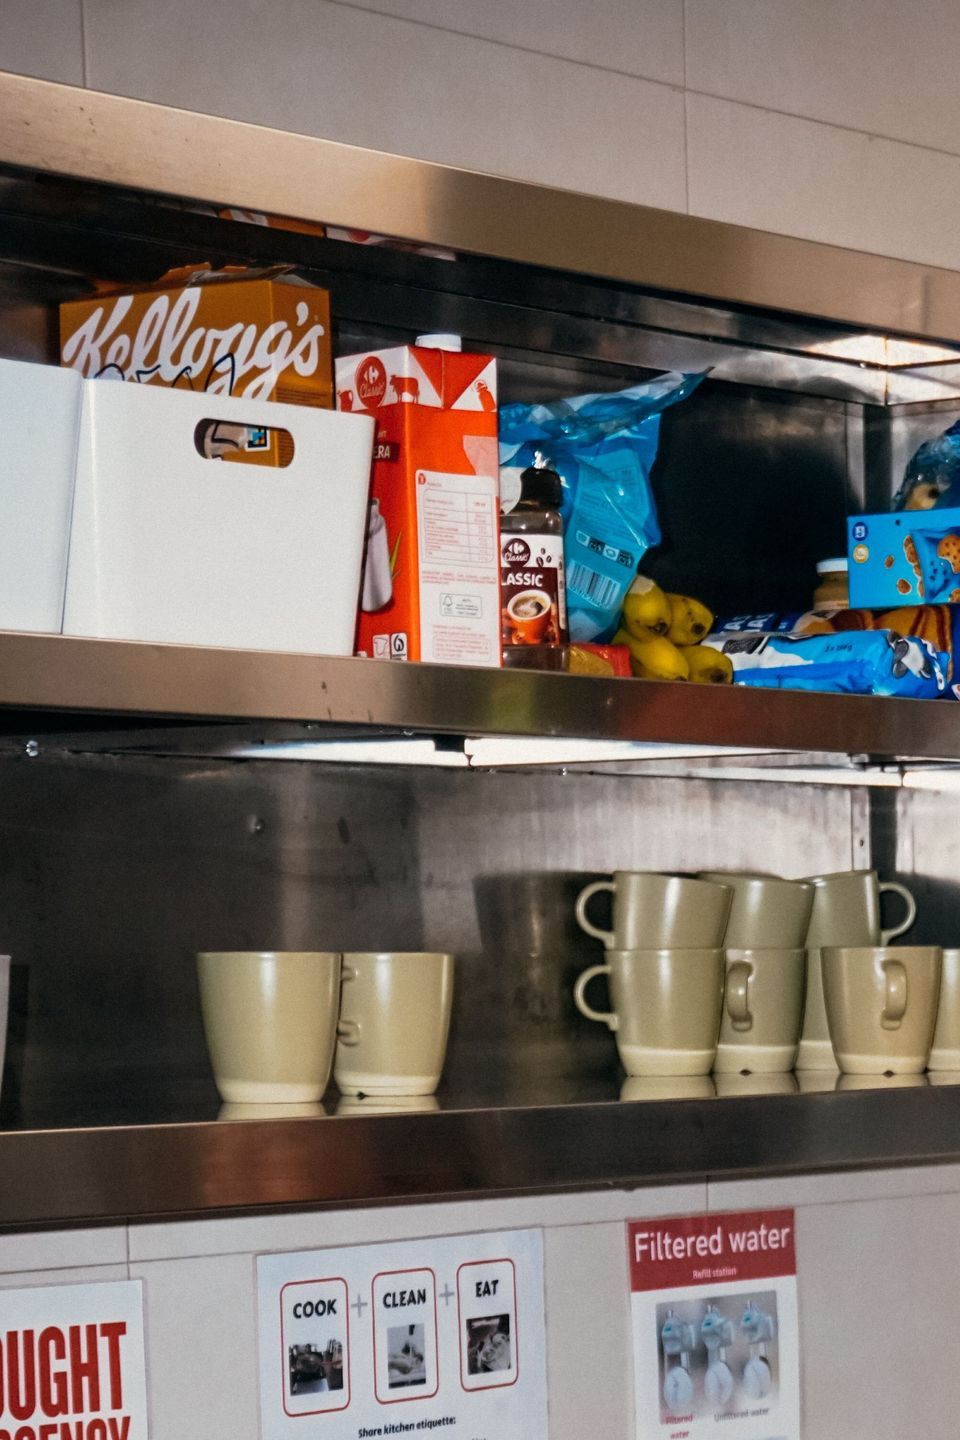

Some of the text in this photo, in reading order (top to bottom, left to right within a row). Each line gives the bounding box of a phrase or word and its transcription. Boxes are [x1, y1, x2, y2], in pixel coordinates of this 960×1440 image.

[63, 286, 325, 401] Kellogg's
[635, 1223, 791, 1263] Filtered water
[692, 1266, 737, 1279] Refill station
[383, 1288, 427, 1309] CLEAN
[475, 1279, 500, 1298] EAT
[293, 1298, 338, 1319] COOK
[0, 1321, 127, 1421] UGHT
[358, 1416, 456, 1439] Share kitchen etiquette:
